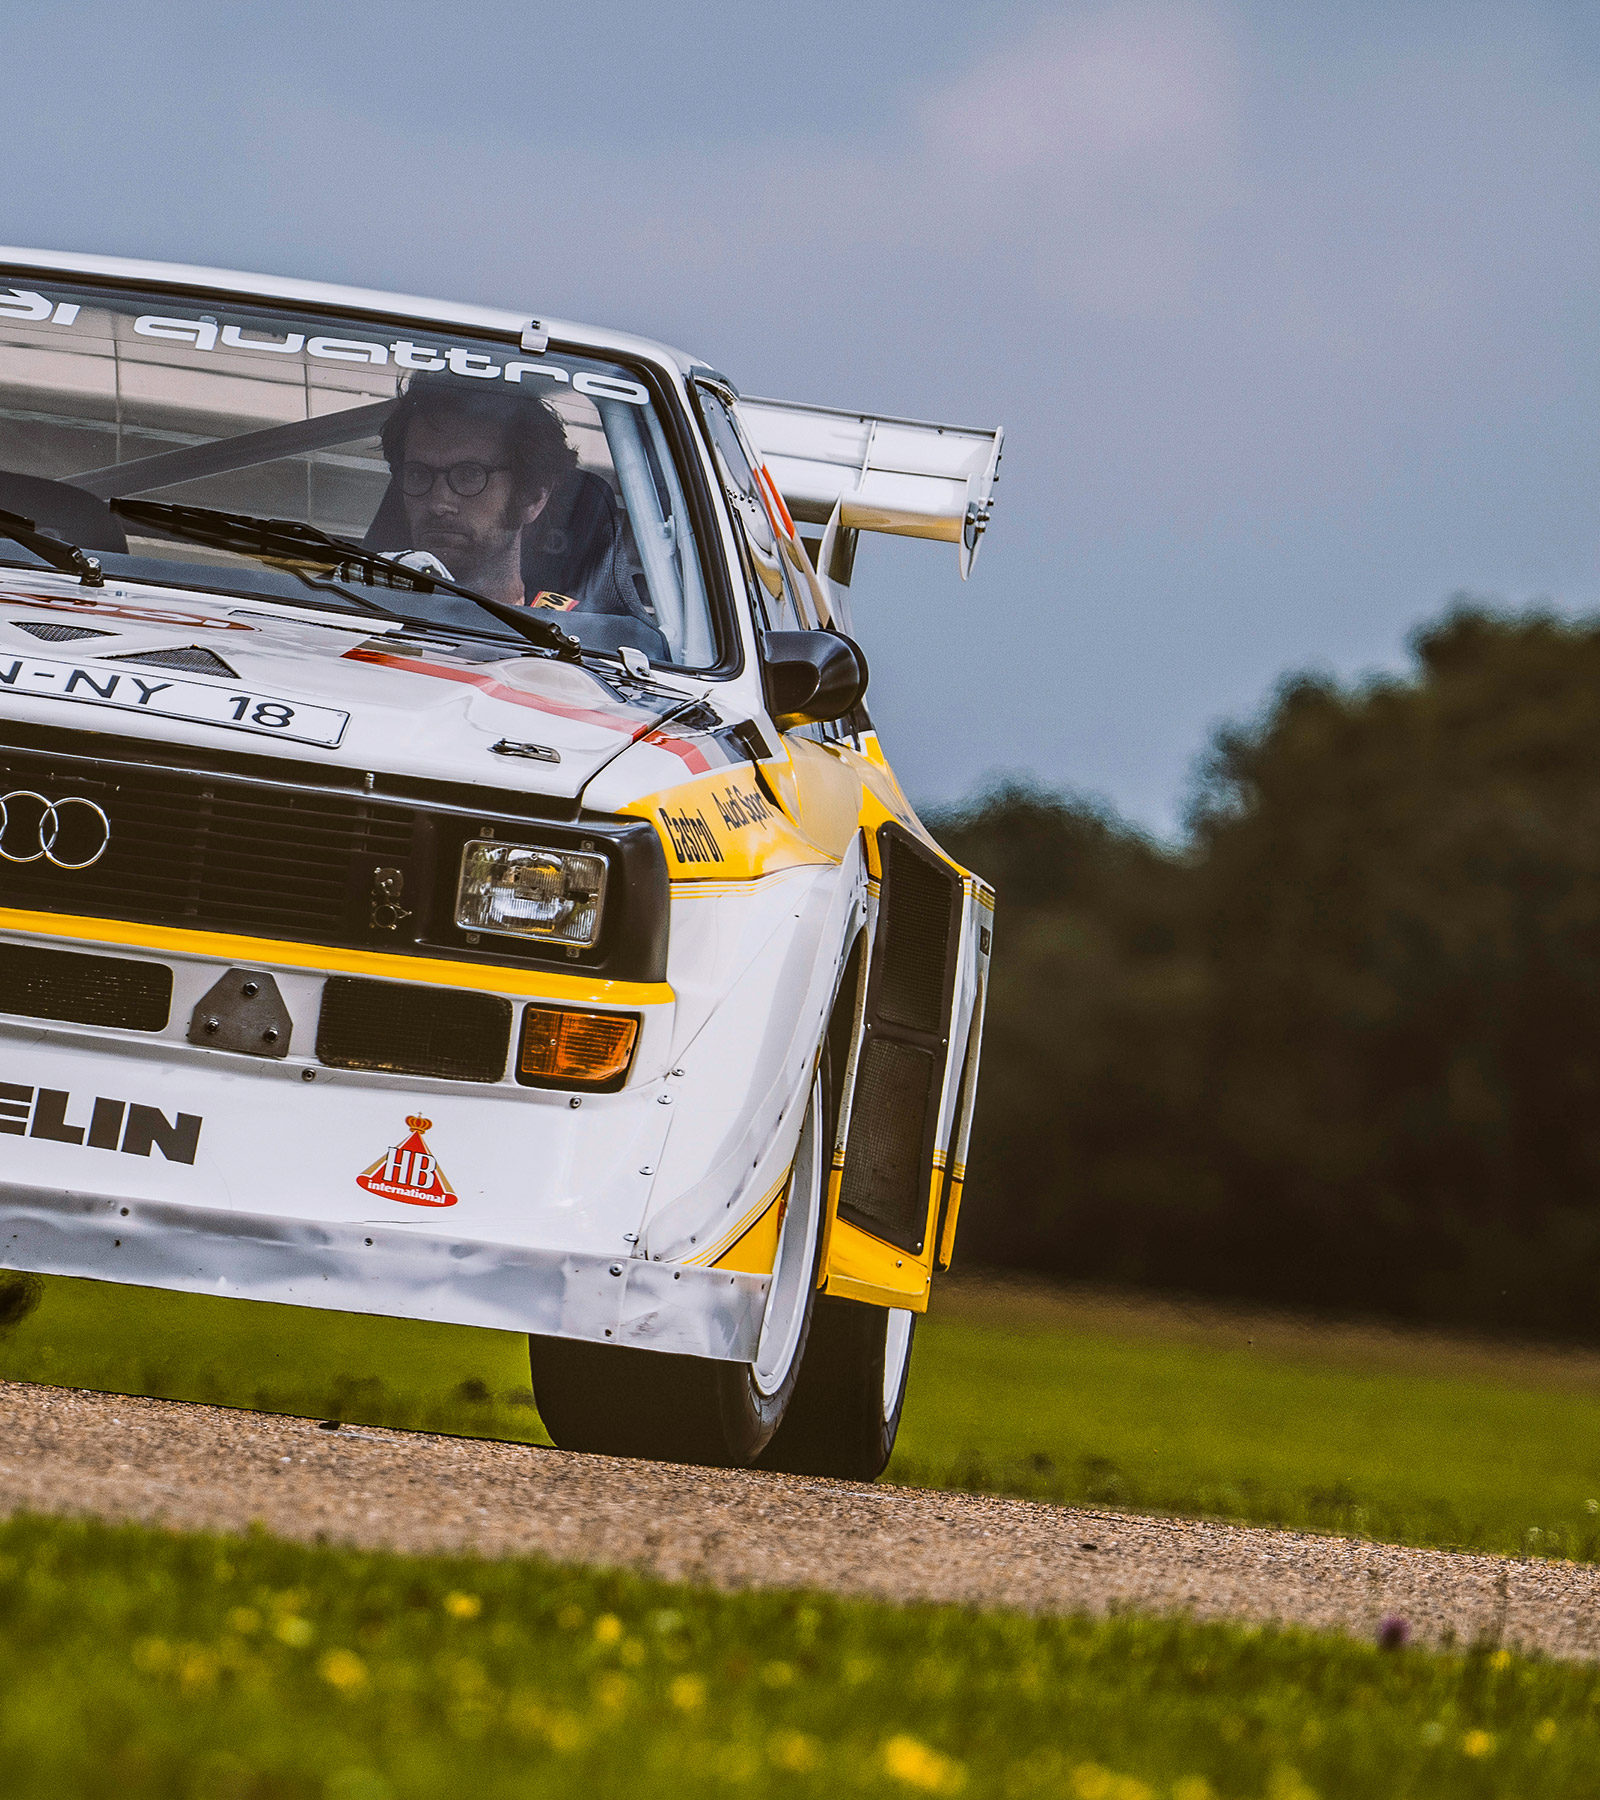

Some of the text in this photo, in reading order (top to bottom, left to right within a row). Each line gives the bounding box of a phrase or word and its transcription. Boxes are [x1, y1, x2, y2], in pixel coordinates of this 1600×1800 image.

[133, 313, 651, 405] quattro
[228, 696, 296, 728] 18
[711, 786, 750, 831] Audi
[658, 807, 725, 863] Castrol
[382, 1146, 438, 1190] HB
[367, 1179, 447, 1204] international
